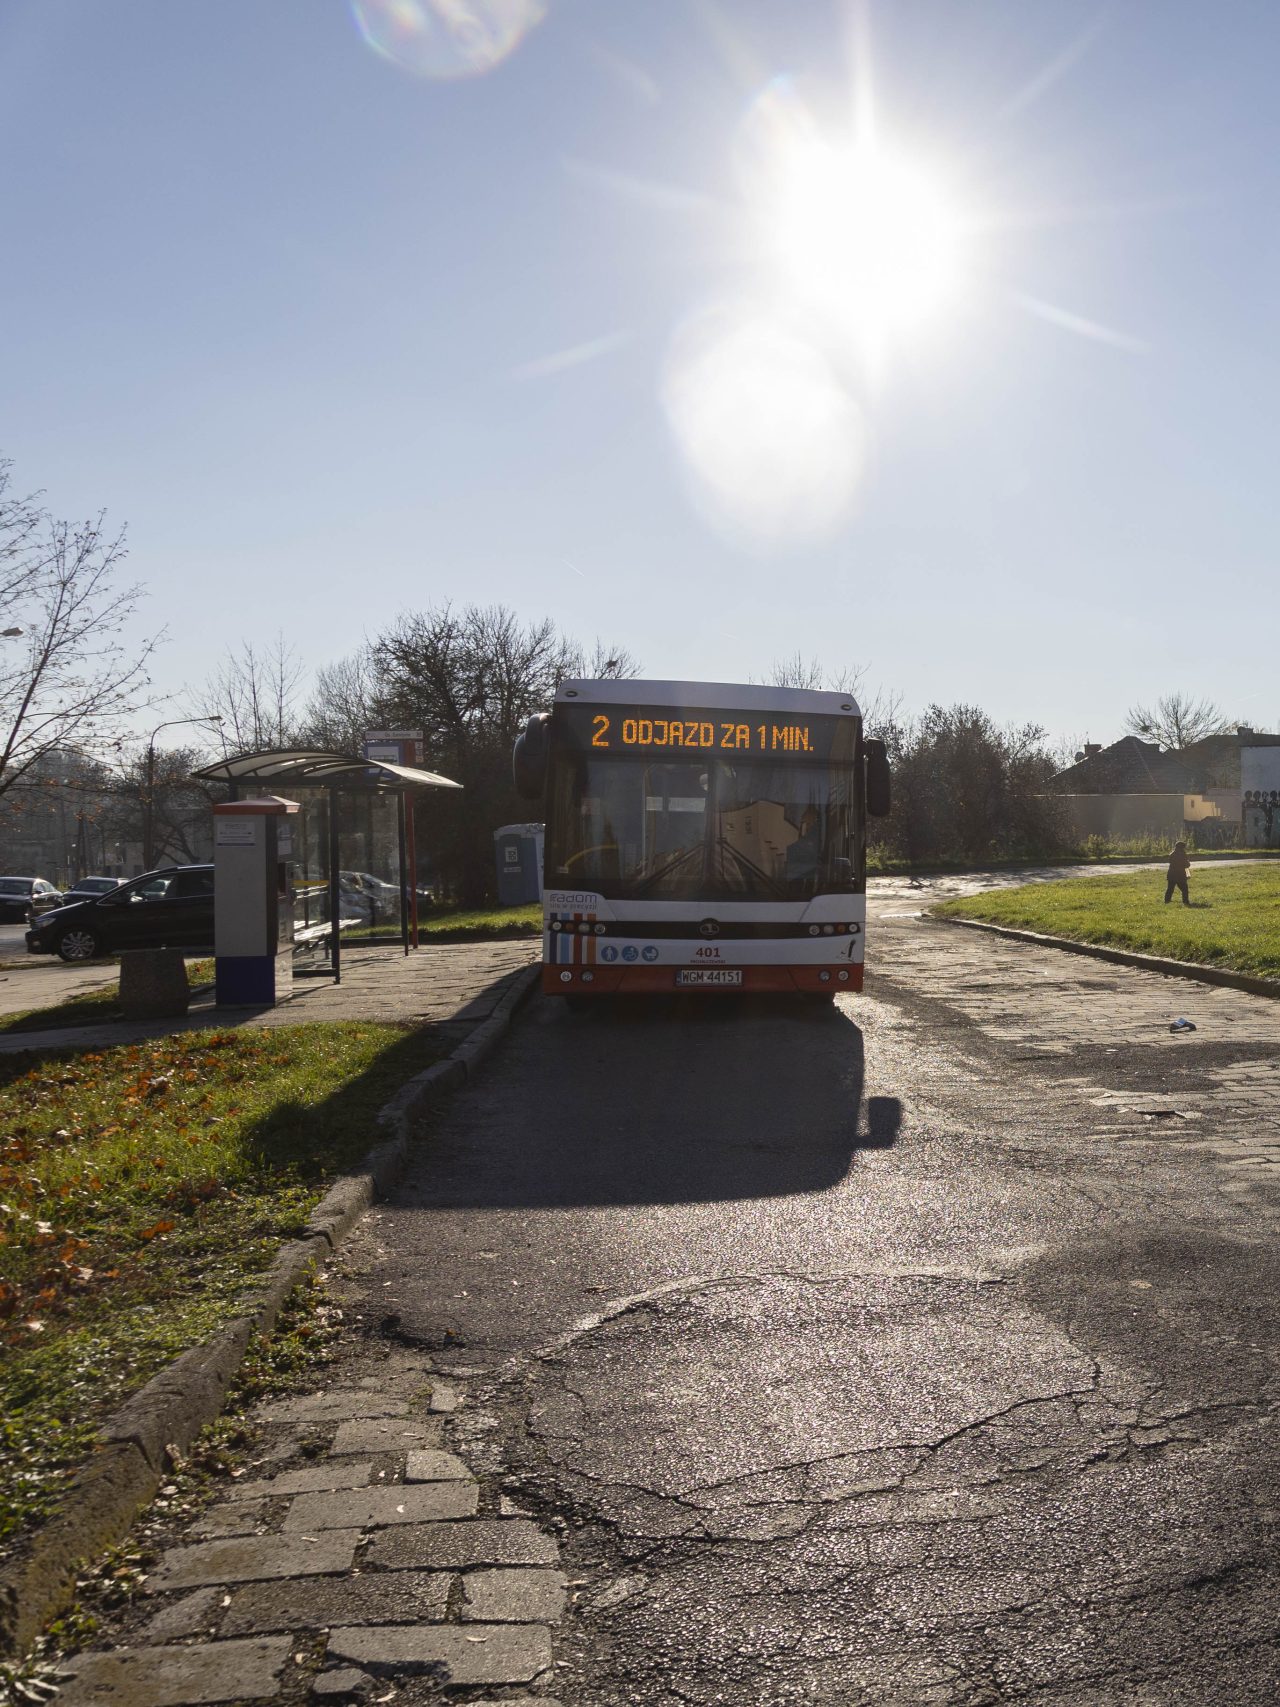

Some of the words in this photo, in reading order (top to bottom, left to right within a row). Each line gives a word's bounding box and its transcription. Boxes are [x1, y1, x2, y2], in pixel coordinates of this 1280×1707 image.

[592, 715, 610, 747] 2
[622, 719, 714, 747] ODJAZD
[720, 723, 750, 749] ZA
[757, 725, 766, 749] 1
[772, 725, 814, 752] MIN.
[695, 947, 721, 958] 401
[682, 971, 704, 982] WGM
[707, 971, 741, 982] 44151
